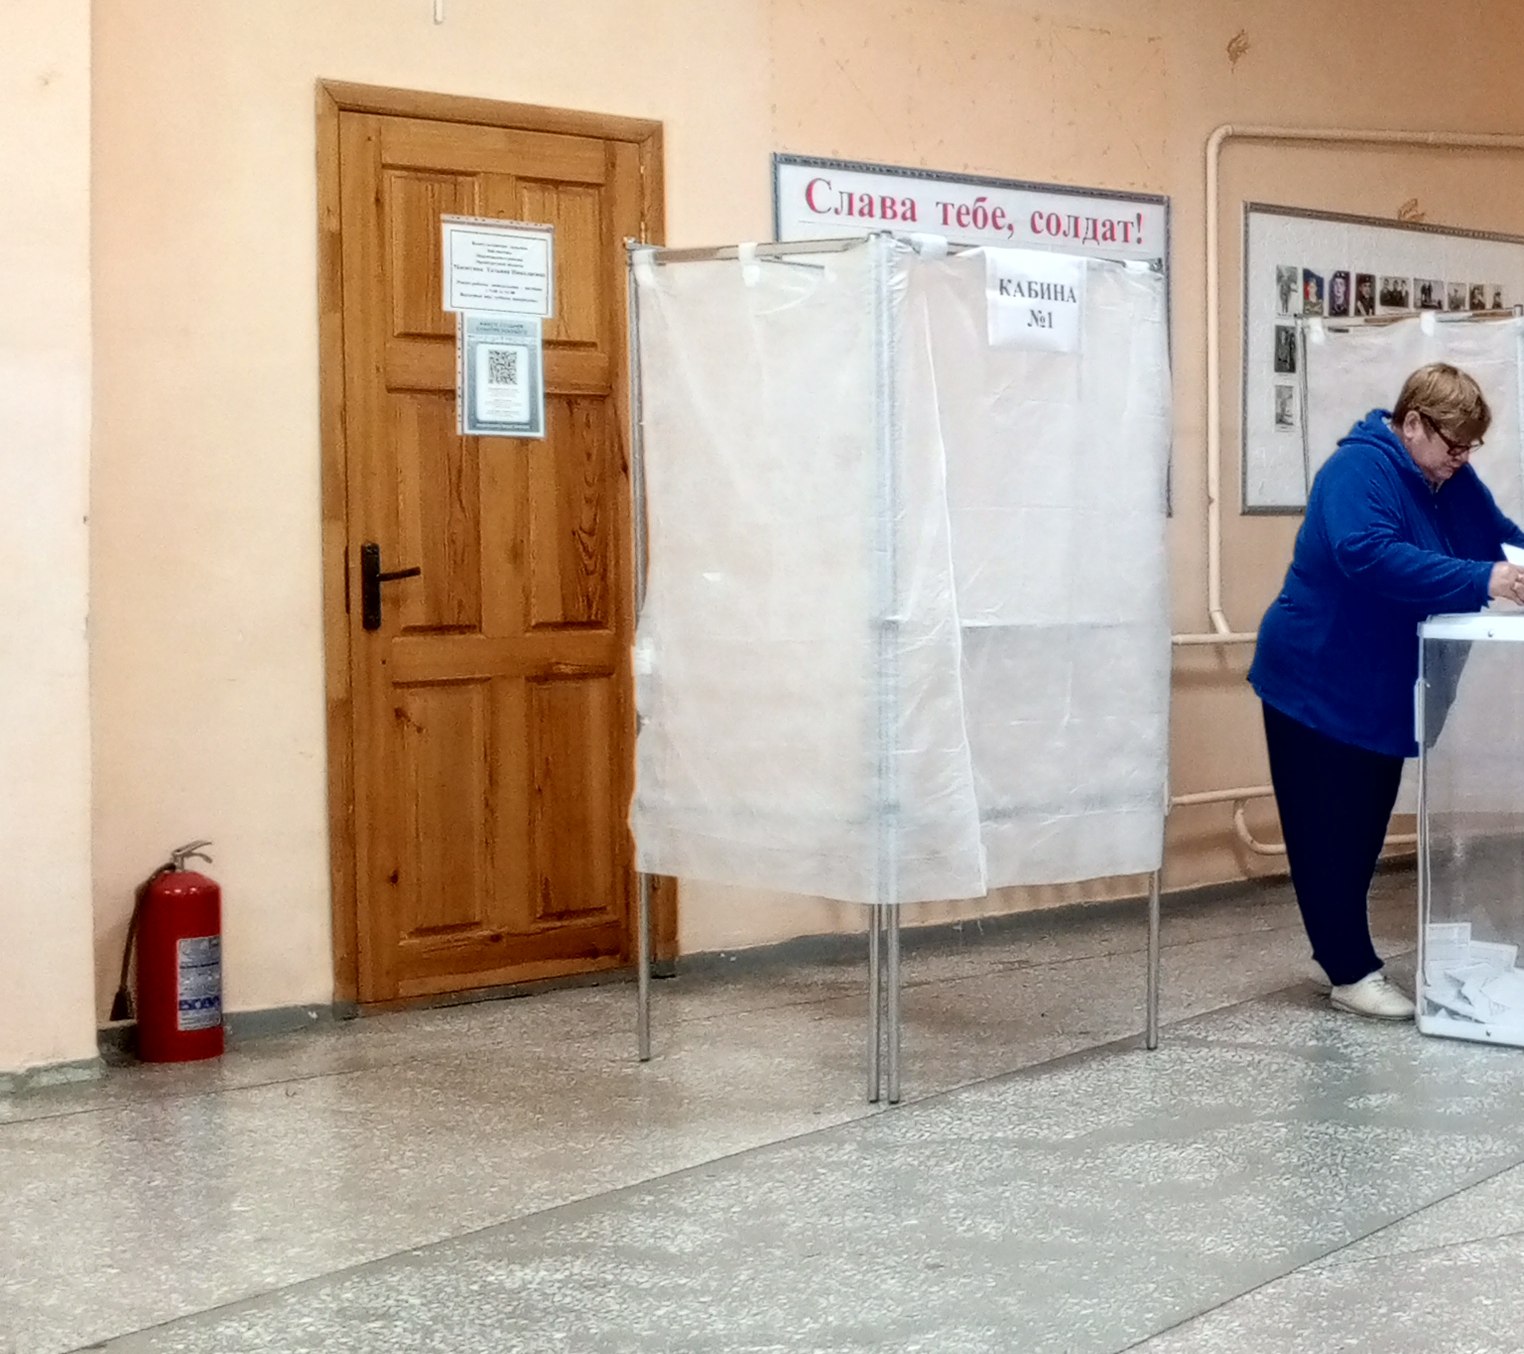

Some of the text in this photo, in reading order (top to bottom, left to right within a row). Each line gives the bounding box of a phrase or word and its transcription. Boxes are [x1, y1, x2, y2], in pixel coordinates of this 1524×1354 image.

[804, 178, 1144, 245] Слава тебе, солдат!
[998, 277, 1077, 303] КАБИНА
[1027, 308, 1054, 329] №1
